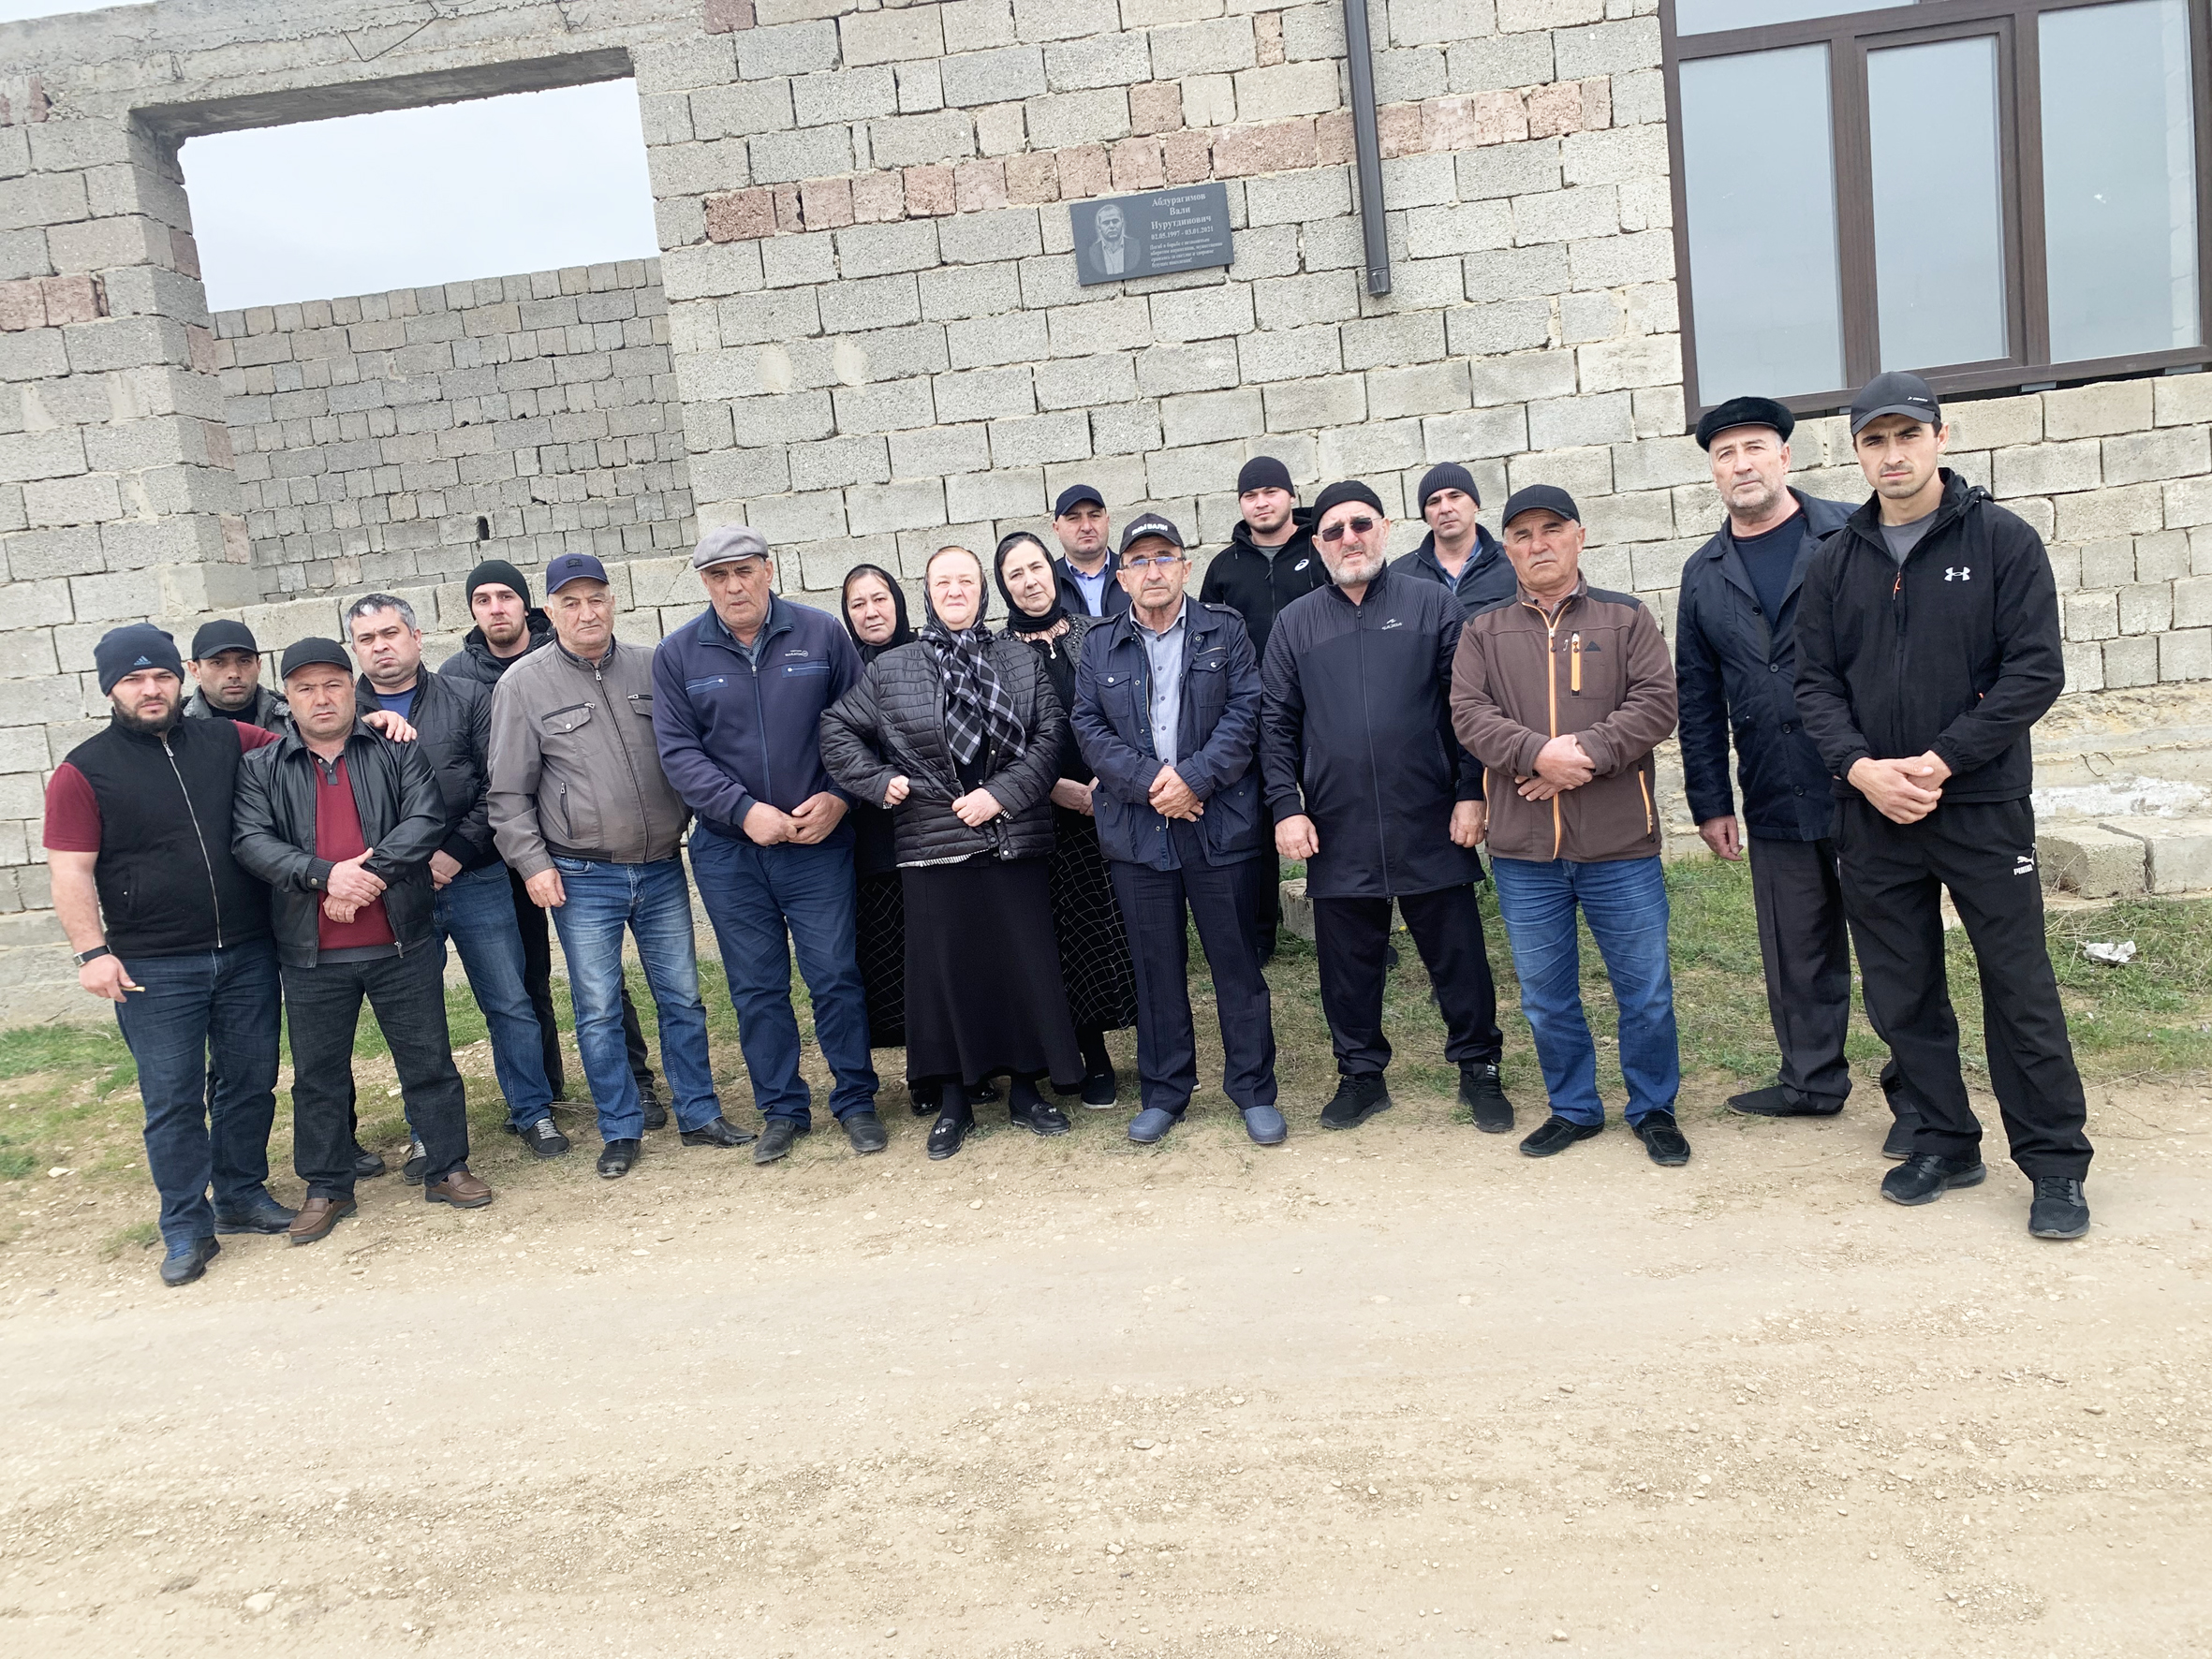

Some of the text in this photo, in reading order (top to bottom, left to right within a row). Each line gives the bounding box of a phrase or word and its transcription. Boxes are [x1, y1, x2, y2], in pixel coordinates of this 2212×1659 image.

[1152, 193, 1206, 207] Абдурагимов
[1170, 207, 1191, 216] Вали
[1151, 215, 1212, 230] Нурутдинович
[2013, 864, 2033, 875] PUMA
